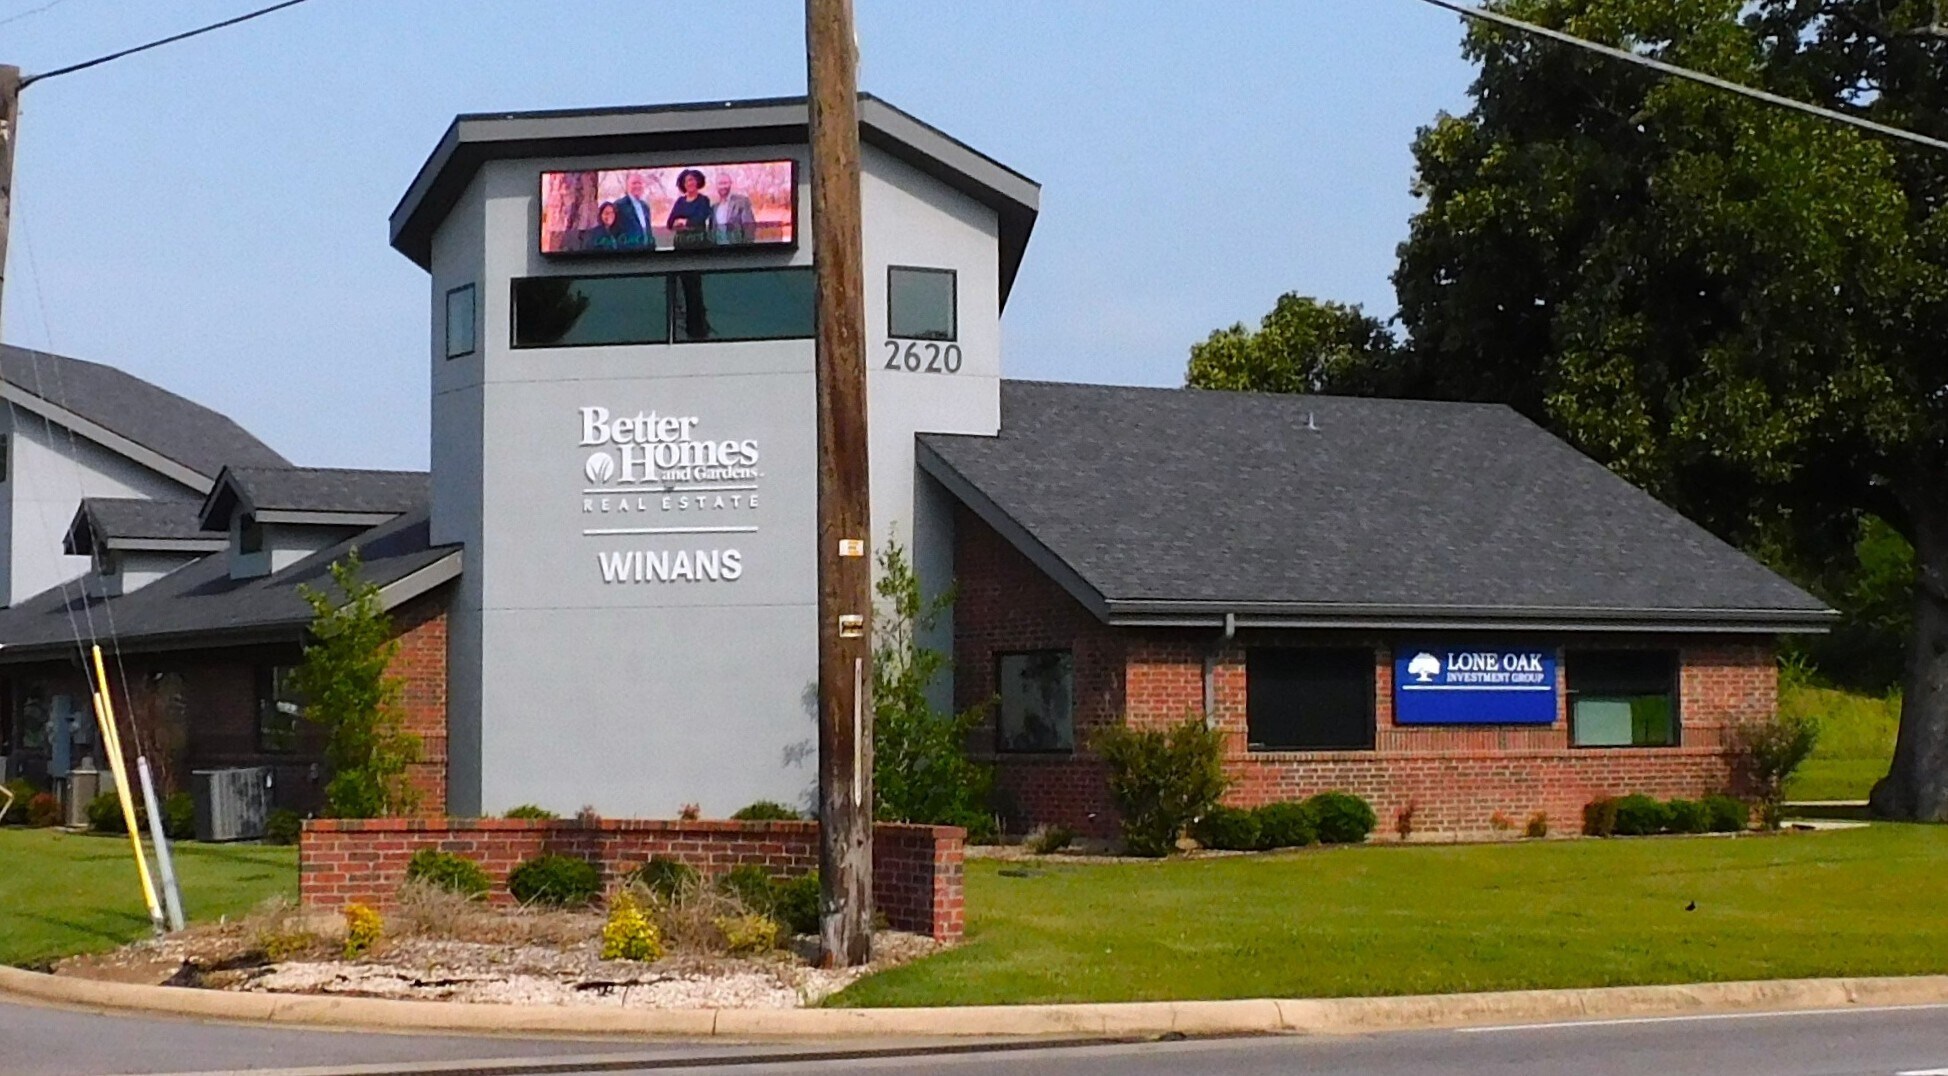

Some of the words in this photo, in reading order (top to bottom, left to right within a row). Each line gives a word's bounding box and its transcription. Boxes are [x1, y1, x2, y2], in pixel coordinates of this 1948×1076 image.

[884, 340, 962, 374] 2620
[579, 406, 699, 447] Better
[617, 439, 759, 485] Homes
[661, 466, 690, 481] and
[693, 466, 758, 482] Gardens
[583, 498, 647, 513] REAL
[661, 495, 759, 510] ESTATE
[598, 549, 742, 583] WINANS
[1447, 653, 1499, 671] LONE
[1503, 653, 1543, 672] OAK
[1446, 672, 1510, 683] INVESTMENT
[1511, 672, 1544, 683] GROUP
